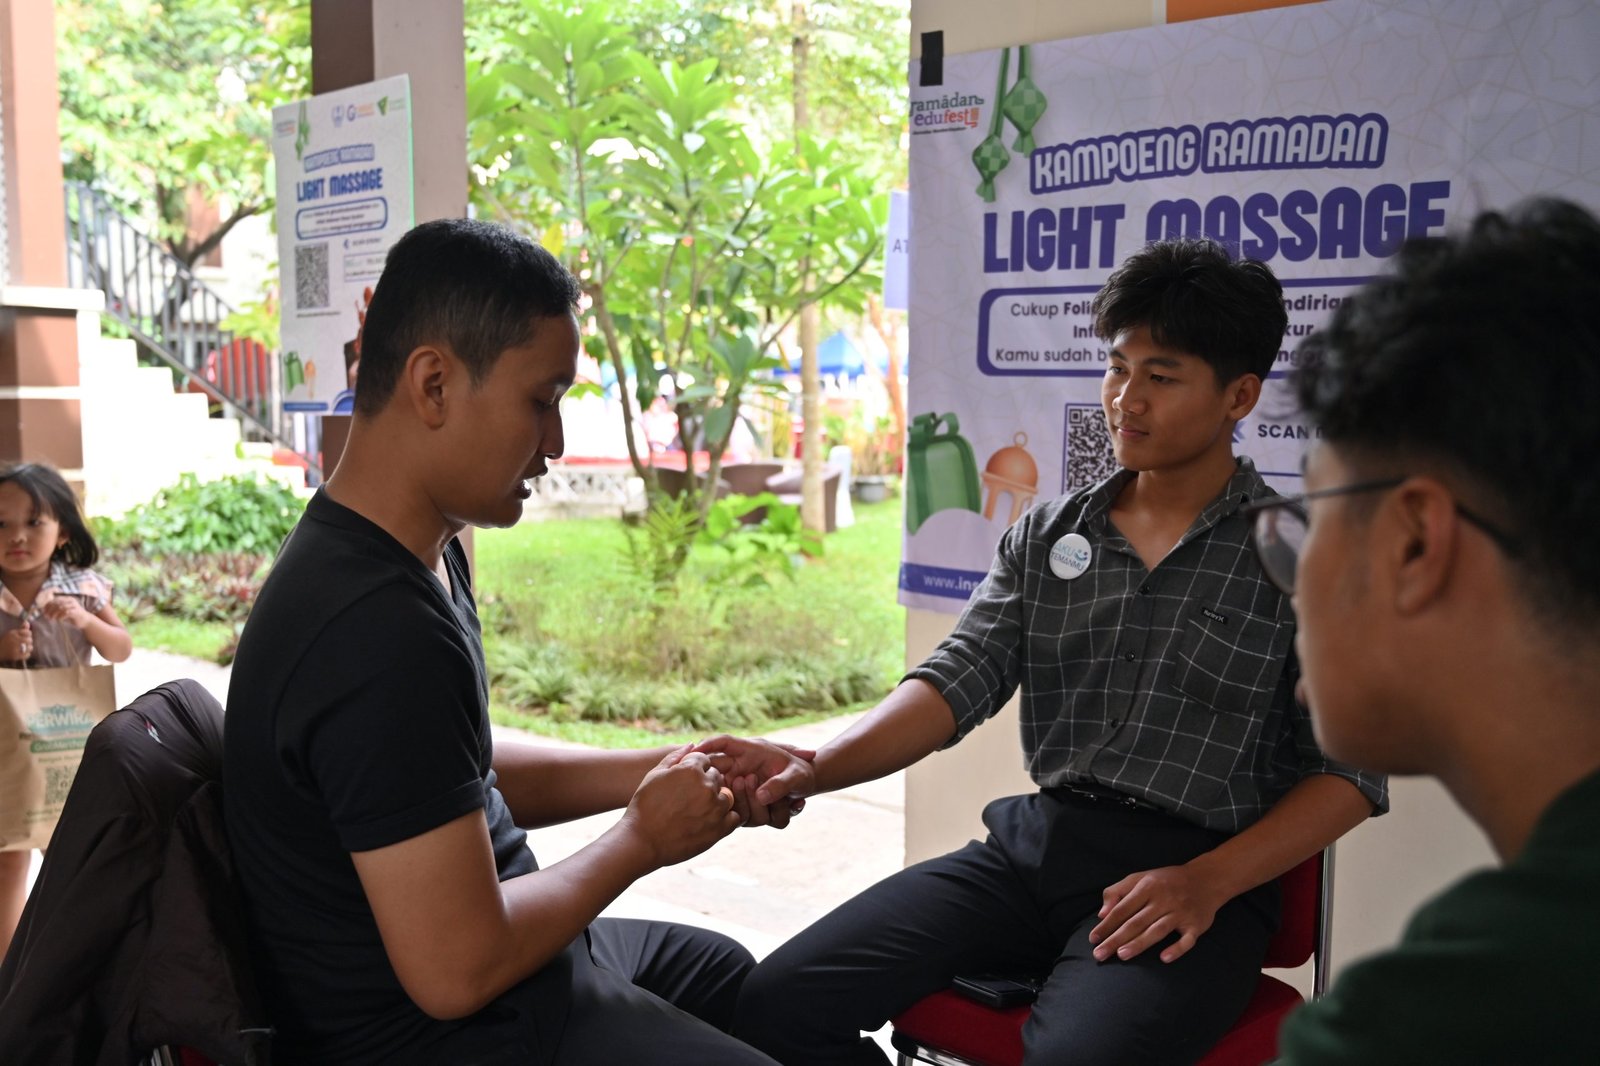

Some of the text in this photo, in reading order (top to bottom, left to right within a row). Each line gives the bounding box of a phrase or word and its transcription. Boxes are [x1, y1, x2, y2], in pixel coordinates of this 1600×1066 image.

[1034, 119, 1382, 190] KAMPOENG RAMADAN
[297, 168, 383, 202] LIGHT MASSAGE
[983, 180, 1451, 274] LIGHT MASSAGE
[1010, 302, 1059, 319] Cukup
[995, 348, 1039, 362] Kamu
[1043, 347, 1092, 362] sudah
[1257, 424, 1310, 439] SCAN
